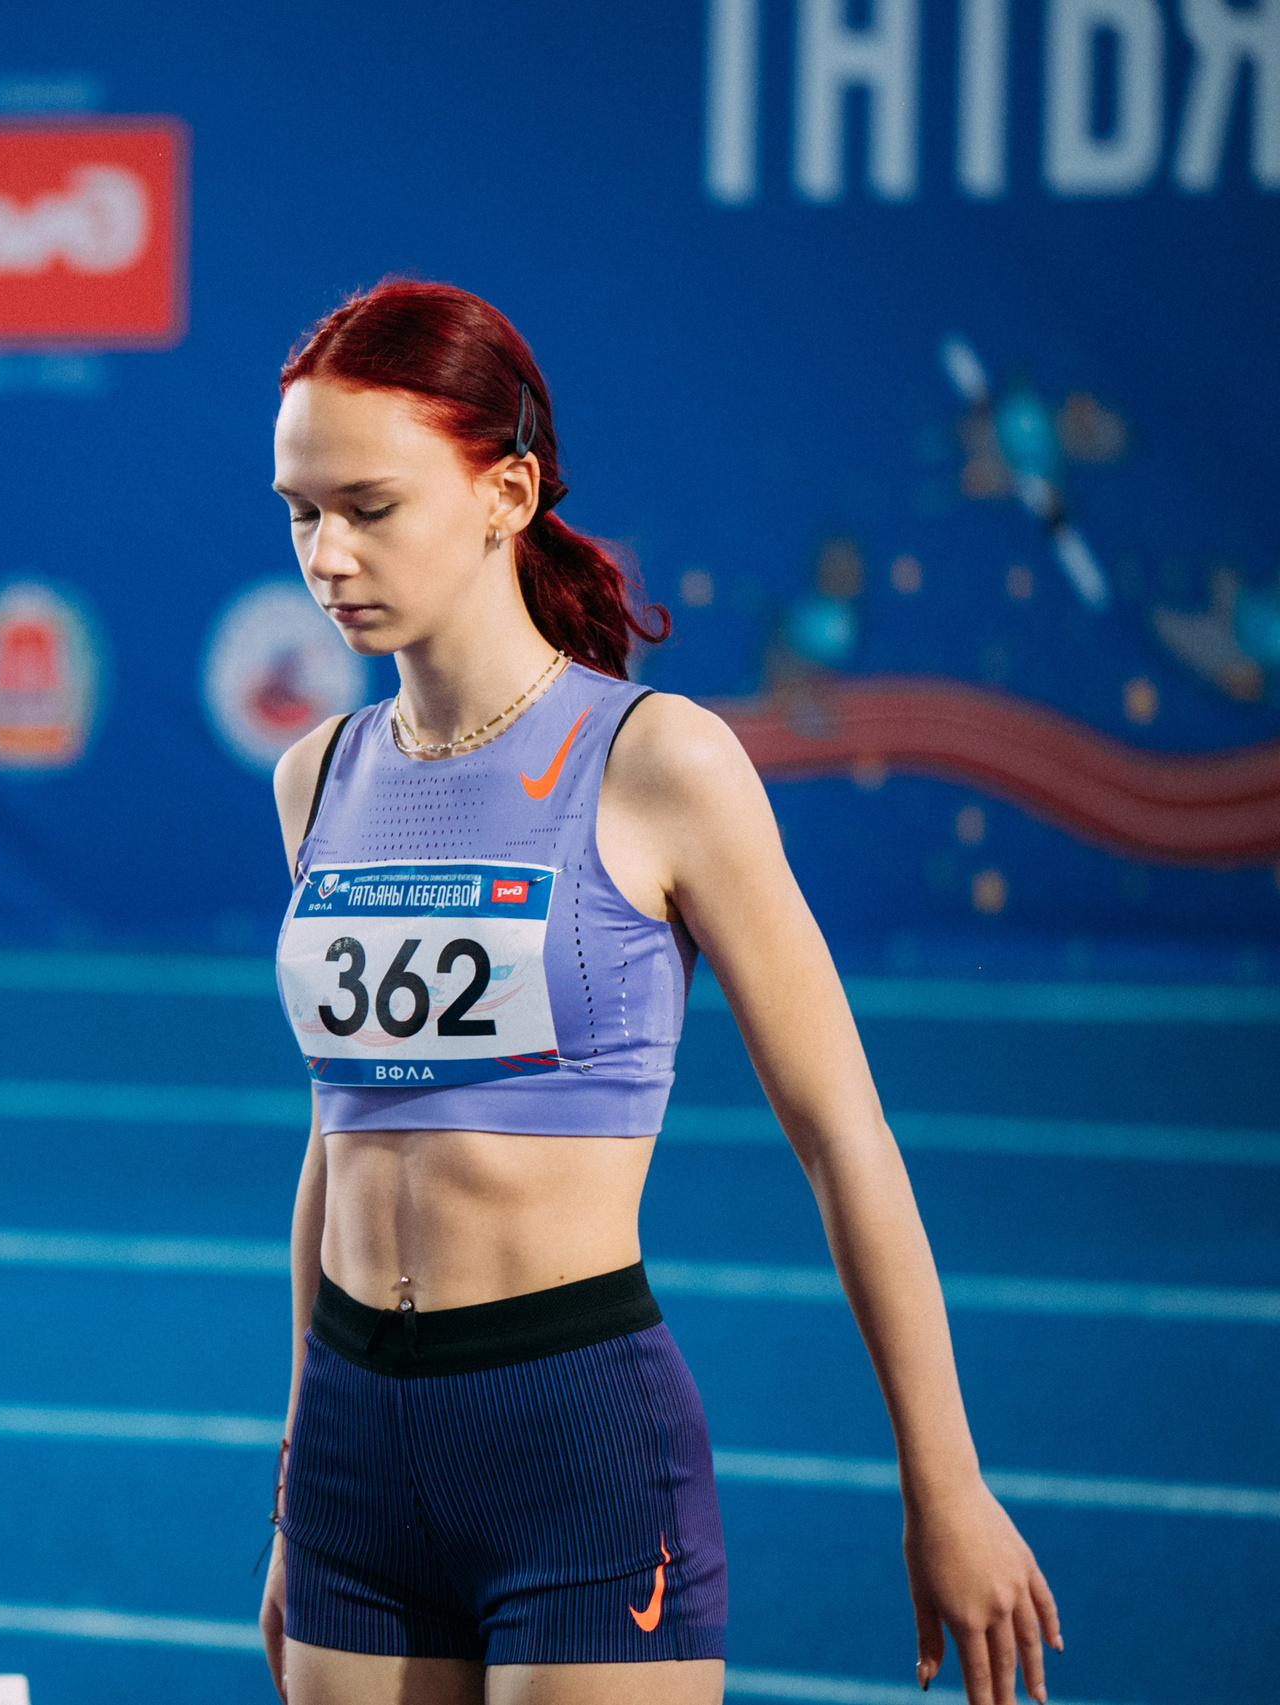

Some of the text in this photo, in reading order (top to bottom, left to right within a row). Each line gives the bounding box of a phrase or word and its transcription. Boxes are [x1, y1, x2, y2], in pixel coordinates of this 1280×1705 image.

[347, 881, 481, 909] ТАТЬЯНЫ ЛЕБЕДЕВОЙ
[308, 902, 332, 911] ВФЛА
[318, 936, 496, 1036] 362
[375, 1065, 435, 1081] ВФЛА
